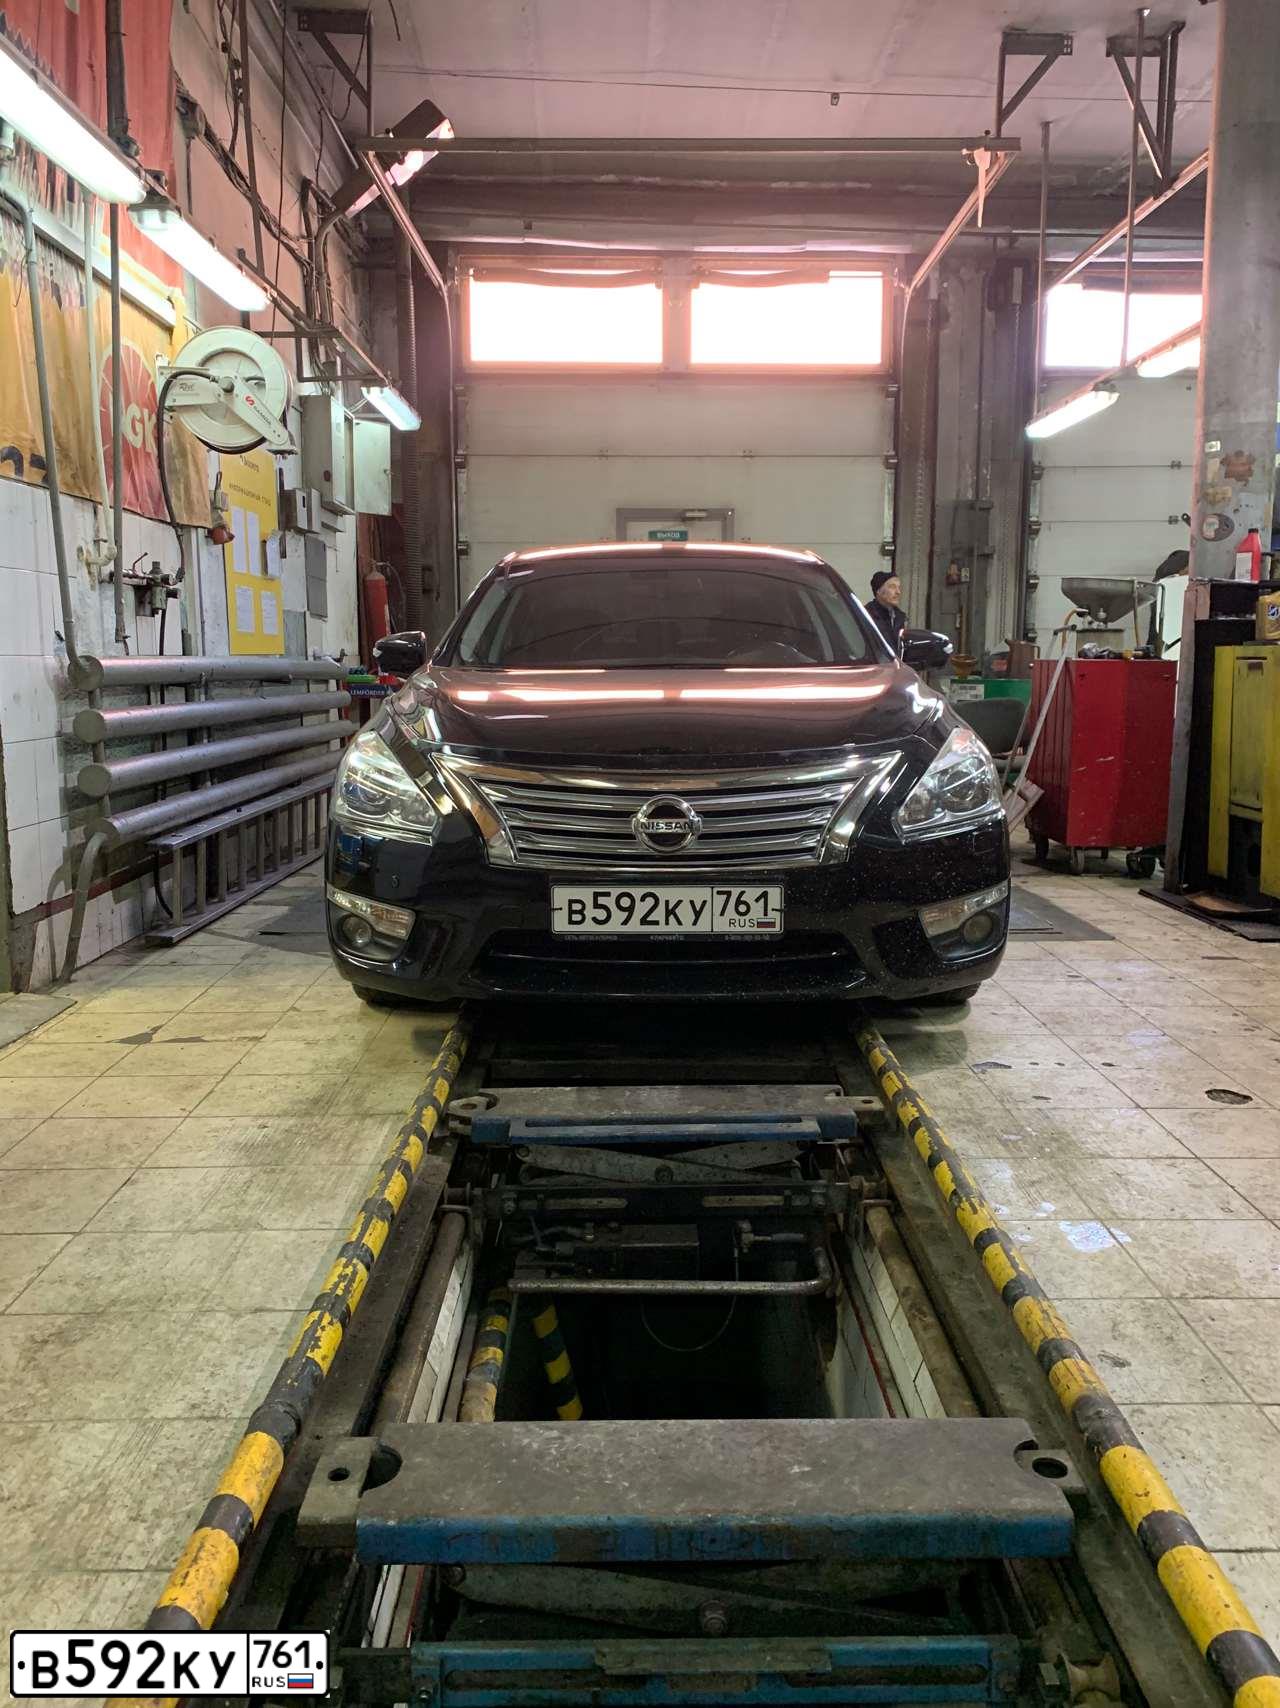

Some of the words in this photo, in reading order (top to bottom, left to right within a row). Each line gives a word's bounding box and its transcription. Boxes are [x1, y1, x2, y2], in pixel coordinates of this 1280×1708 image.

[640, 820, 693, 831] NISSAN
[567, 890, 708, 926] В592КУ
[715, 890, 769, 917] 761
[728, 918, 756, 928] RUS
